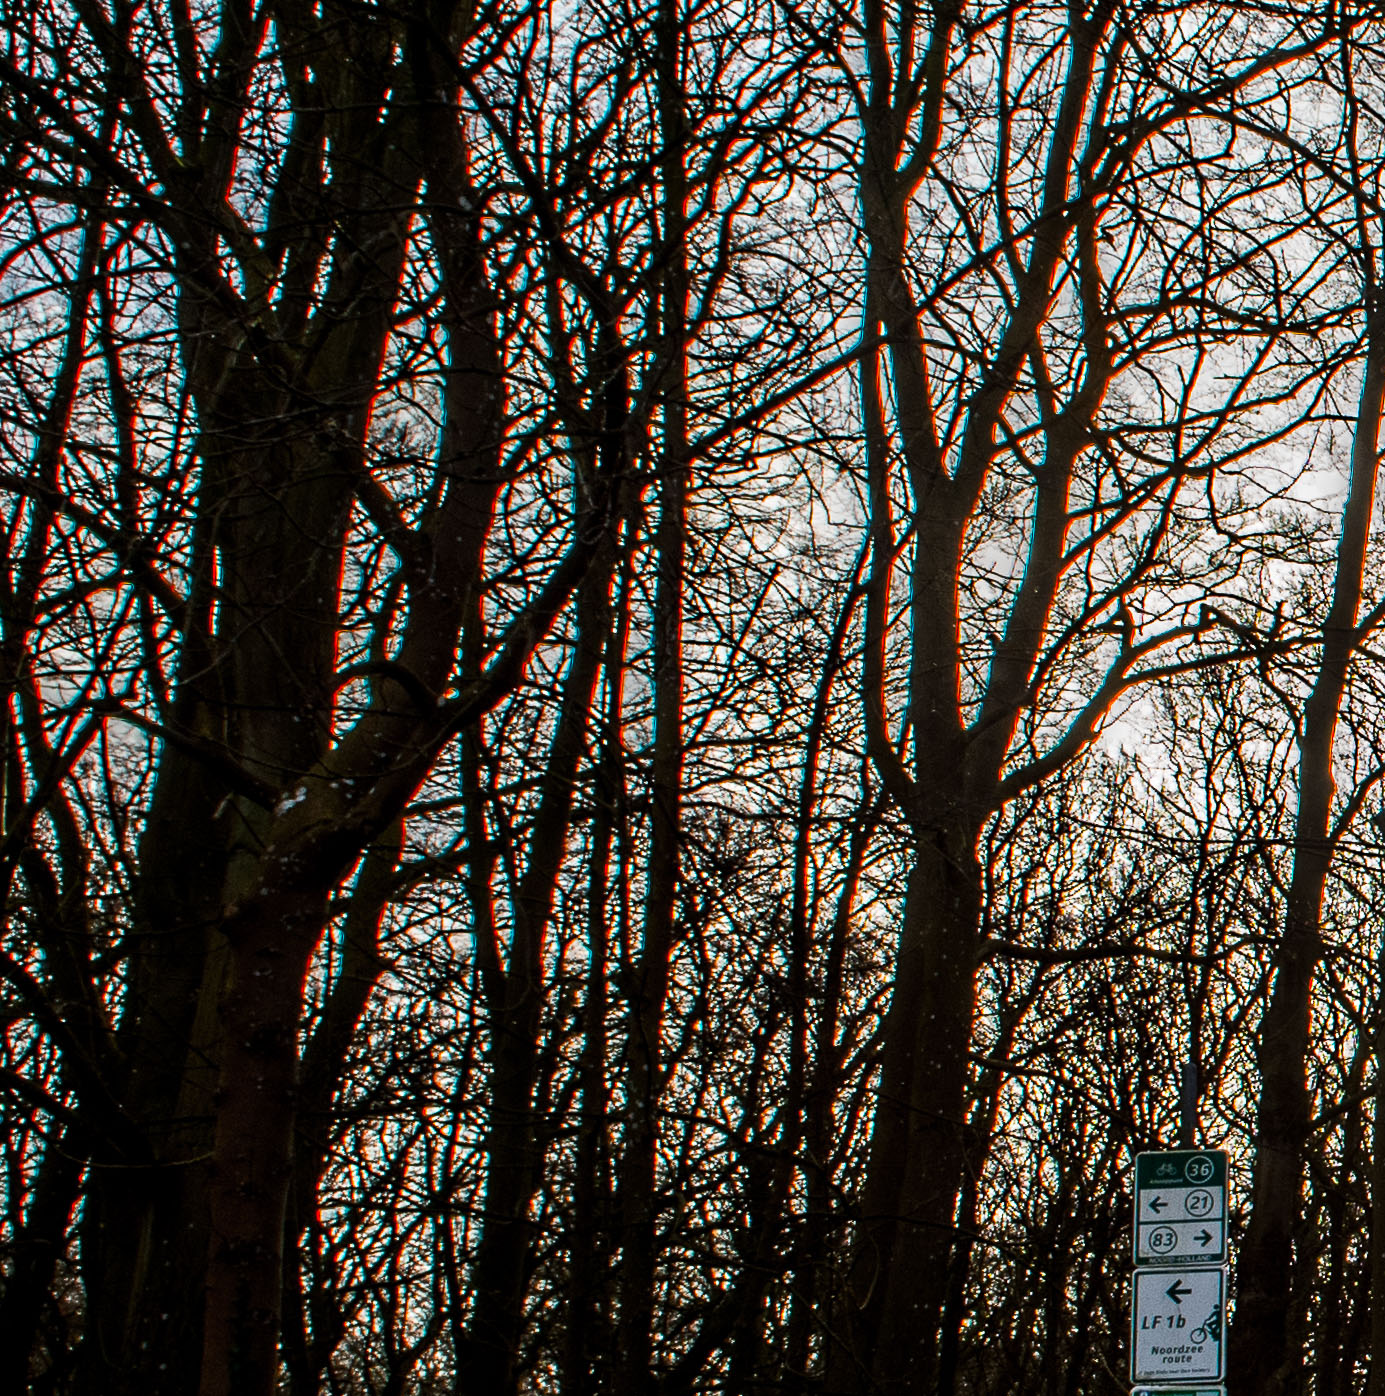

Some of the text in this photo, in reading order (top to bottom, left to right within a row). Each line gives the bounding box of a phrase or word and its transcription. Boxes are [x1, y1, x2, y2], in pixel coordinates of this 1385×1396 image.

[1190, 1163, 1209, 1177] 36
[1190, 1196, 1208, 1210] 21
[1153, 1233, 1174, 1247] 83
[1141, 1313, 1187, 1330] LF 1b
[1151, 1344, 1204, 1355] Noordzee
[1162, 1355, 1193, 1364] route
